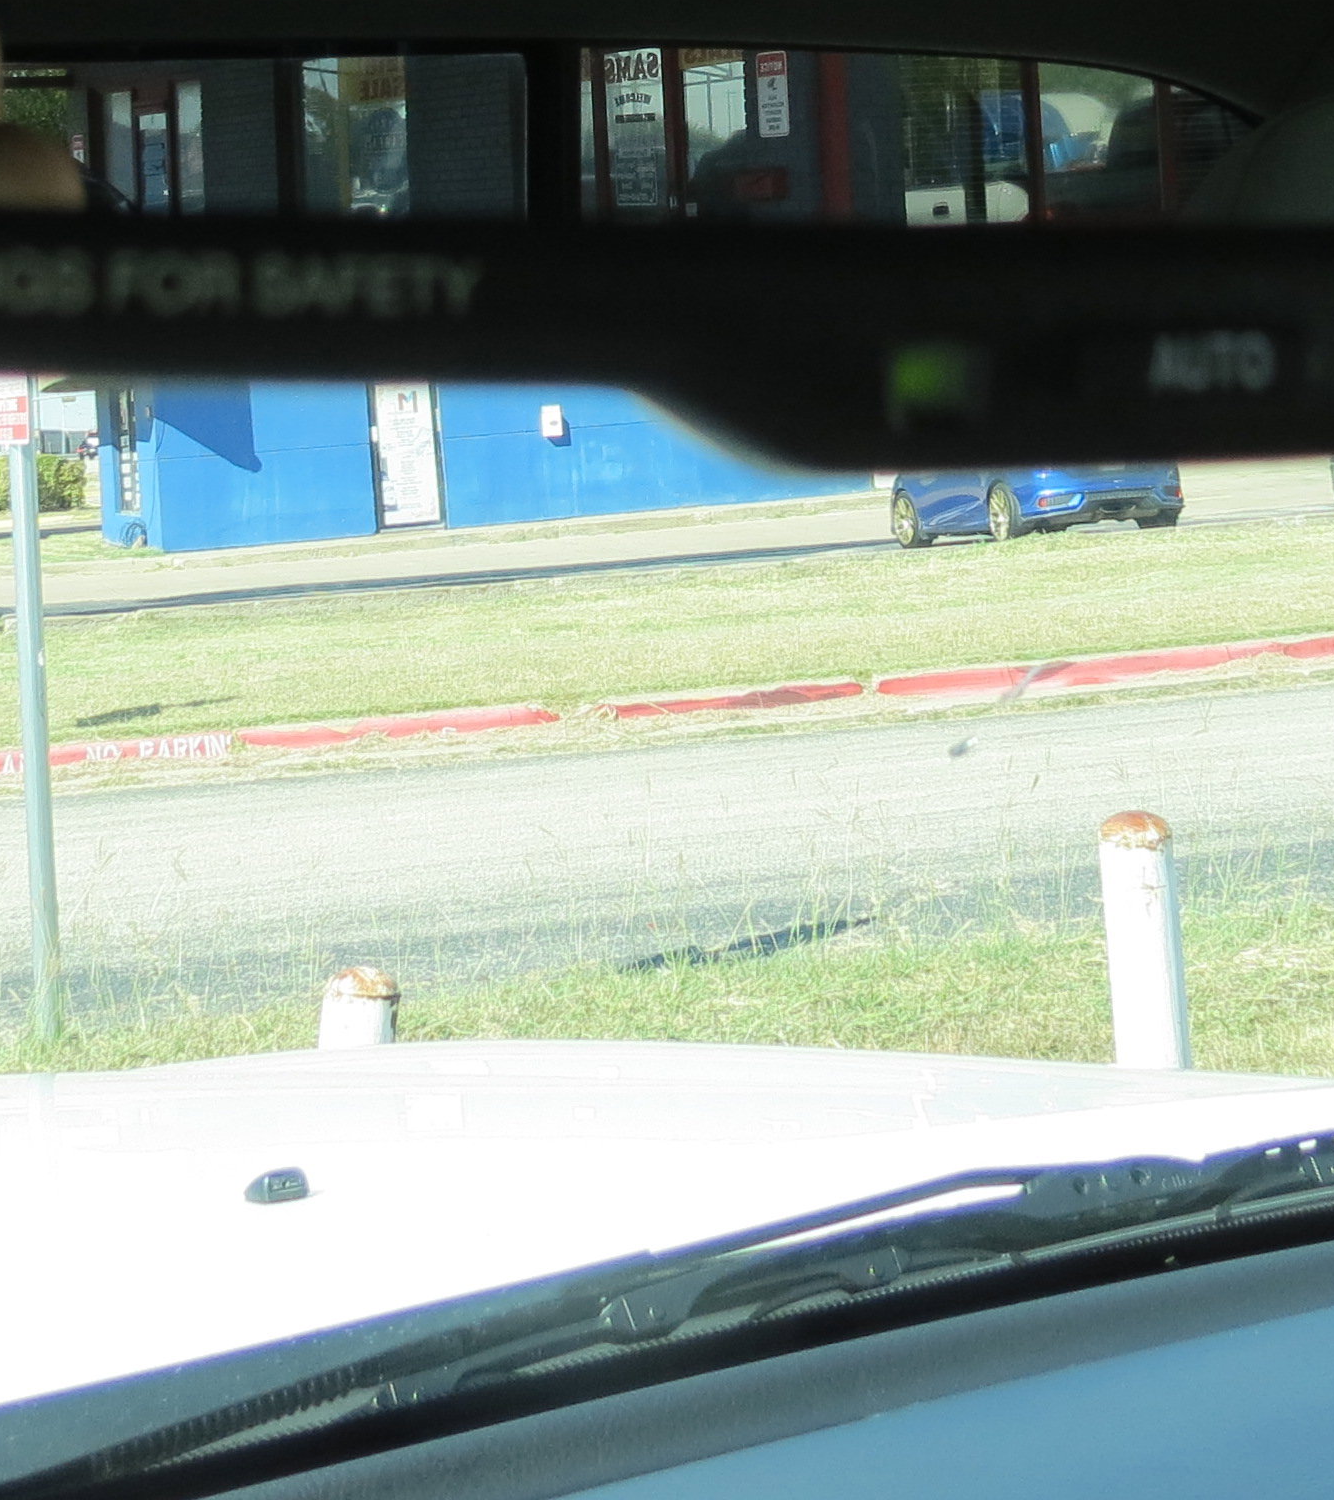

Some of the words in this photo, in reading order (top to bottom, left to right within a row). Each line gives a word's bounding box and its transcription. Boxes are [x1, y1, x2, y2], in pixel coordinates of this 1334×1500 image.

[106, 247, 243, 316] FOR
[251, 250, 484, 318] SAFETY
[1148, 329, 1279, 393] AUTO
